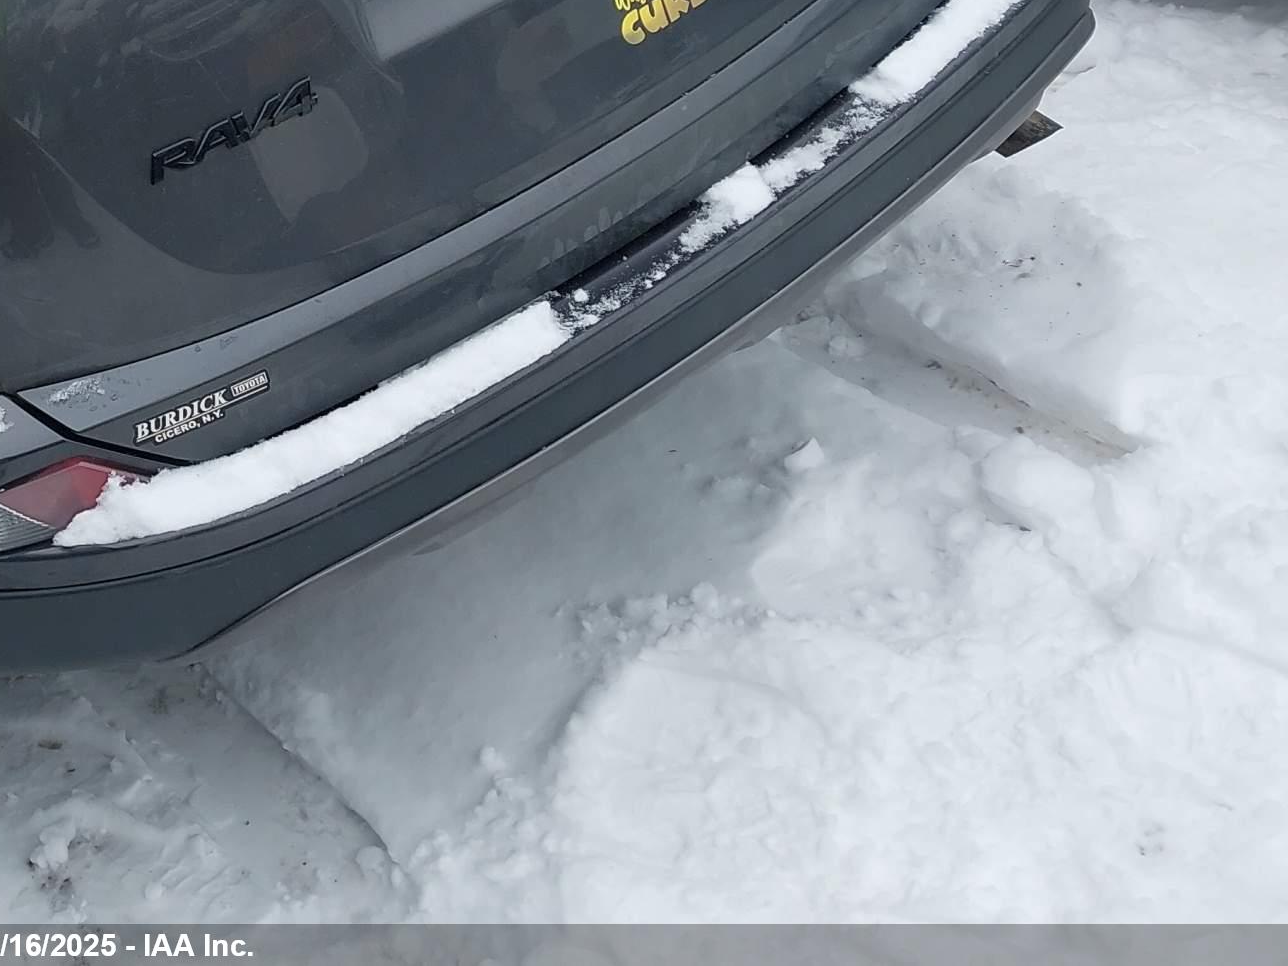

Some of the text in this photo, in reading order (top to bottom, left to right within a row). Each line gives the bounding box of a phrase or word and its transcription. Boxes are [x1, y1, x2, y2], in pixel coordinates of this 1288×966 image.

[150, 76, 319, 186] RAV4
[135, 374, 267, 440] BURDICK TOYOTA
[154, 409, 225, 444] CICERO, N.Y.
